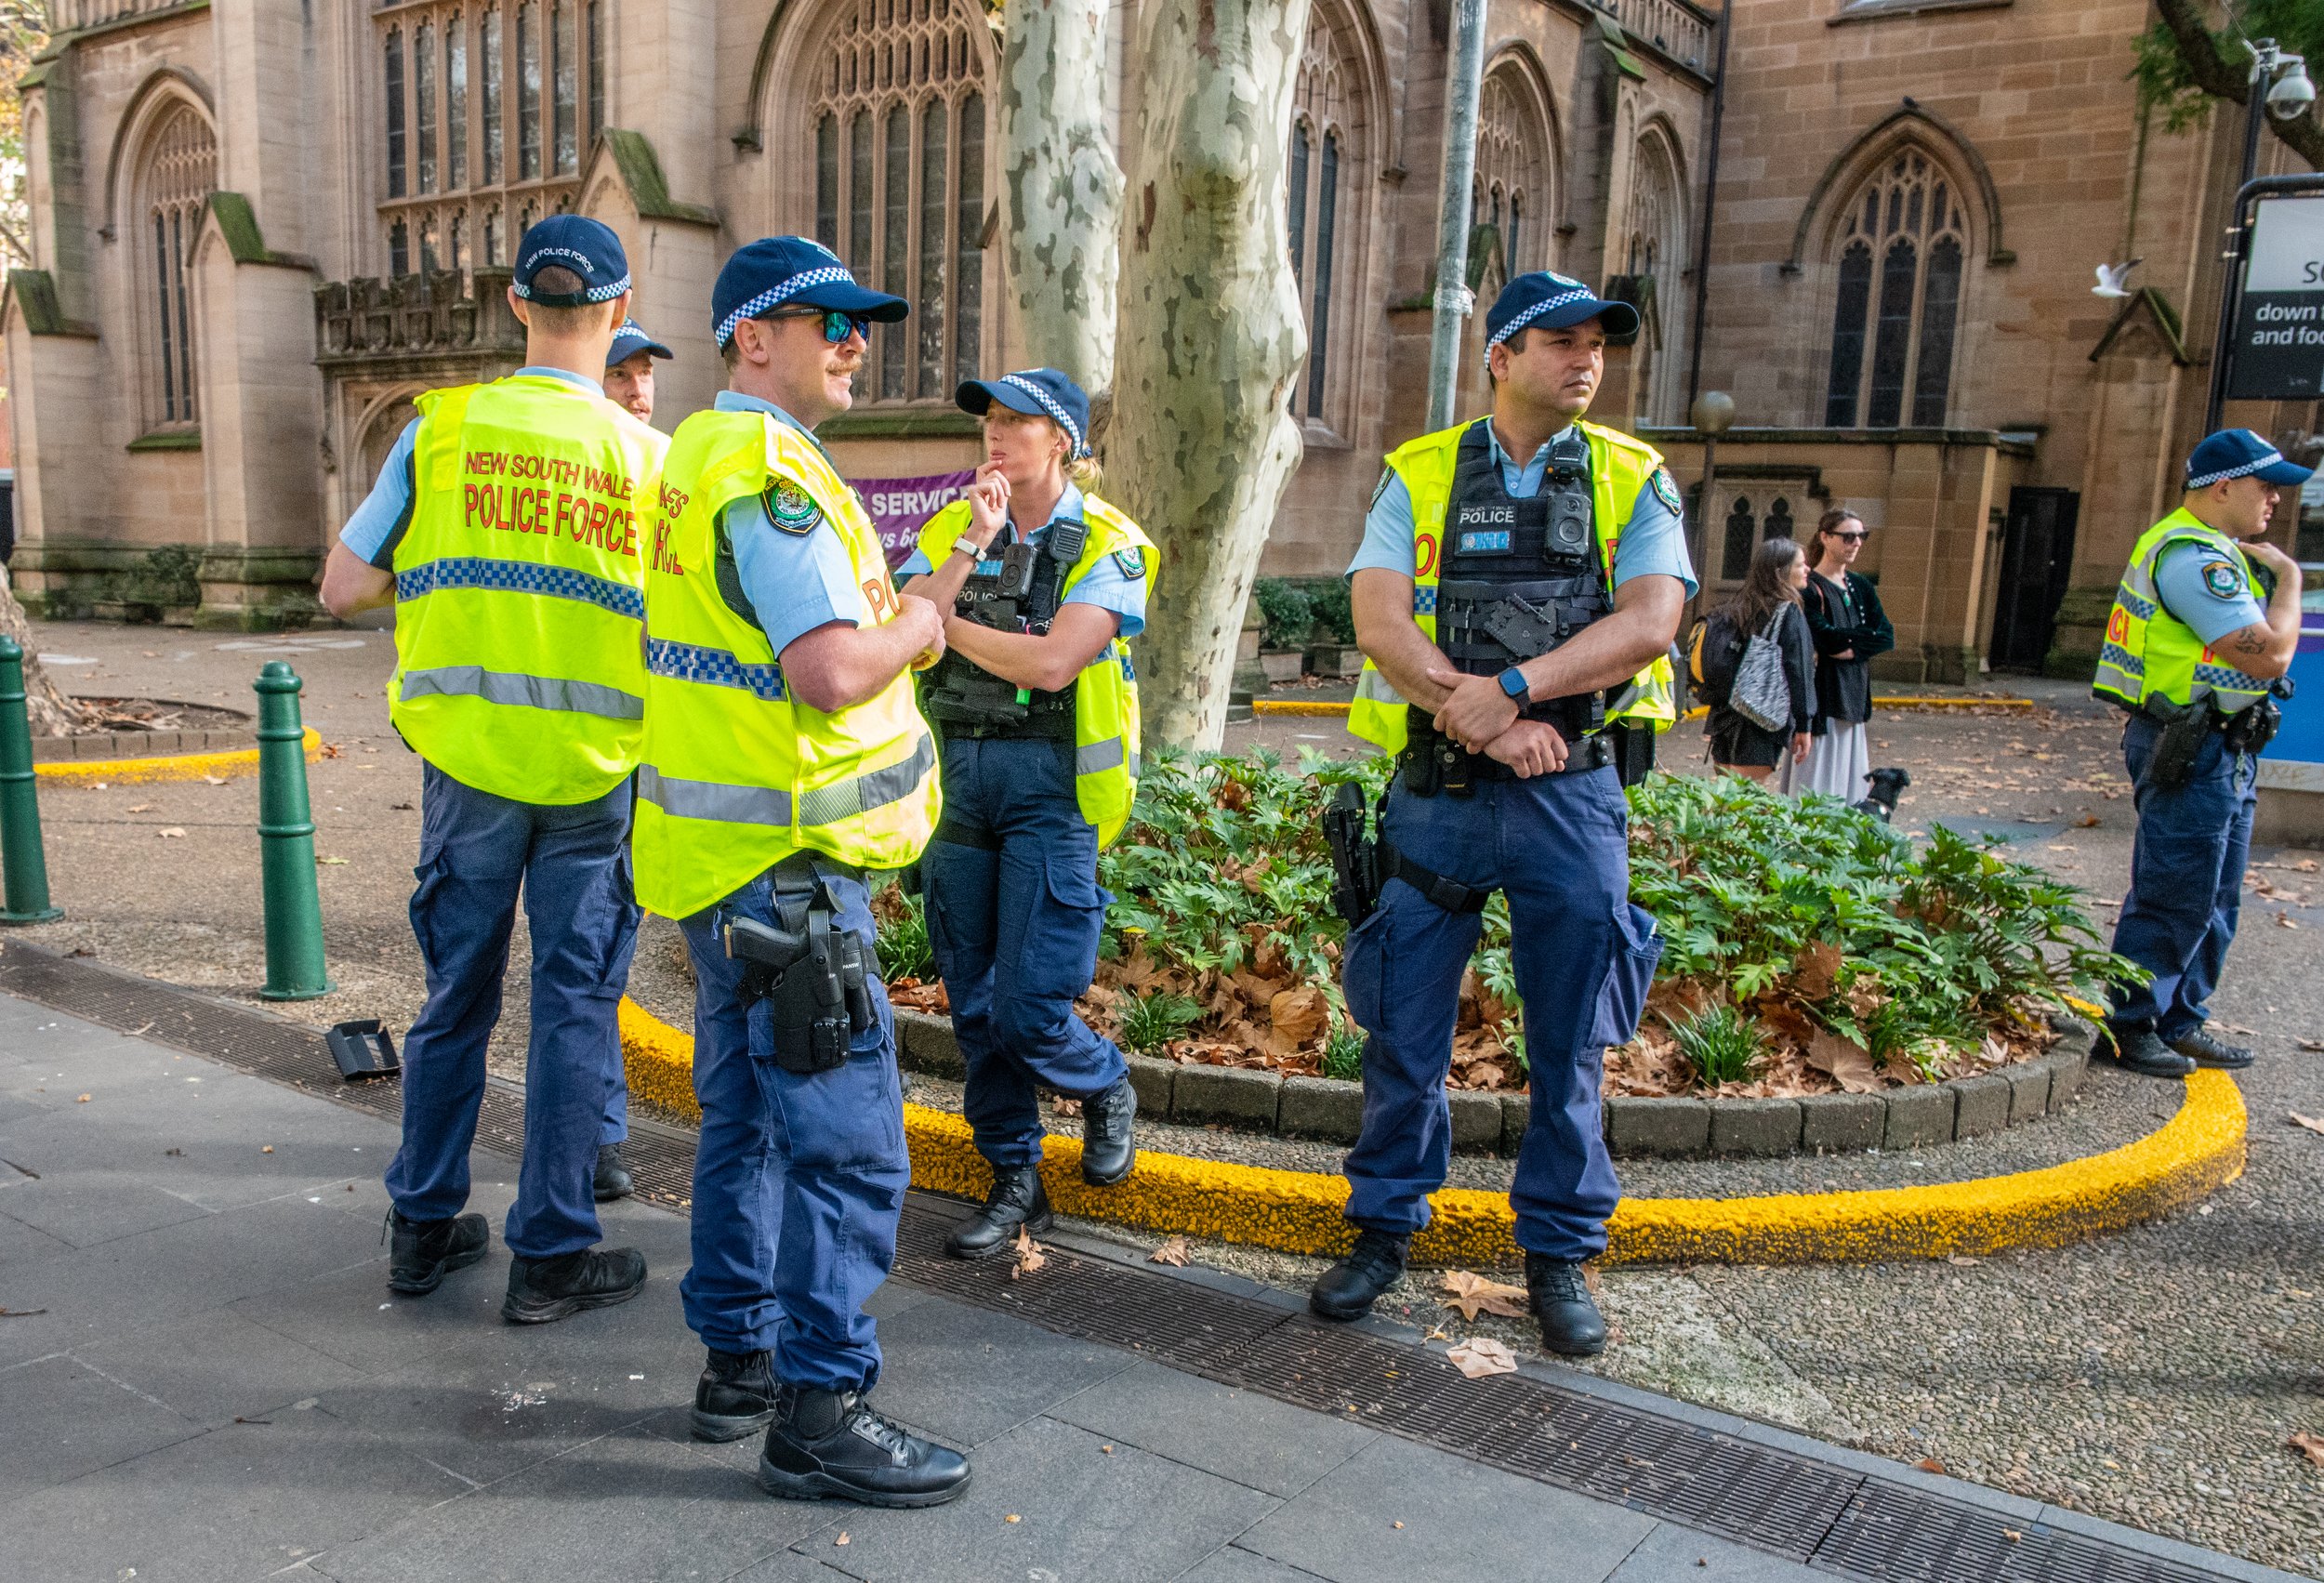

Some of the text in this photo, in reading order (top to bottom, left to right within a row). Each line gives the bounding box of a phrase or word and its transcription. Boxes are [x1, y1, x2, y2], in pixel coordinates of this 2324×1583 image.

[524, 247, 595, 273] NSW POLICE FORCE
[2302, 261, 2324, 284] S
[2254, 302, 2317, 322] down
[2251, 326, 2294, 345] and
[465, 452, 635, 501] NEW SOUTH WALE
[464, 483, 637, 557] POLICE FORCE
[1459, 510, 1514, 523] POLICE
